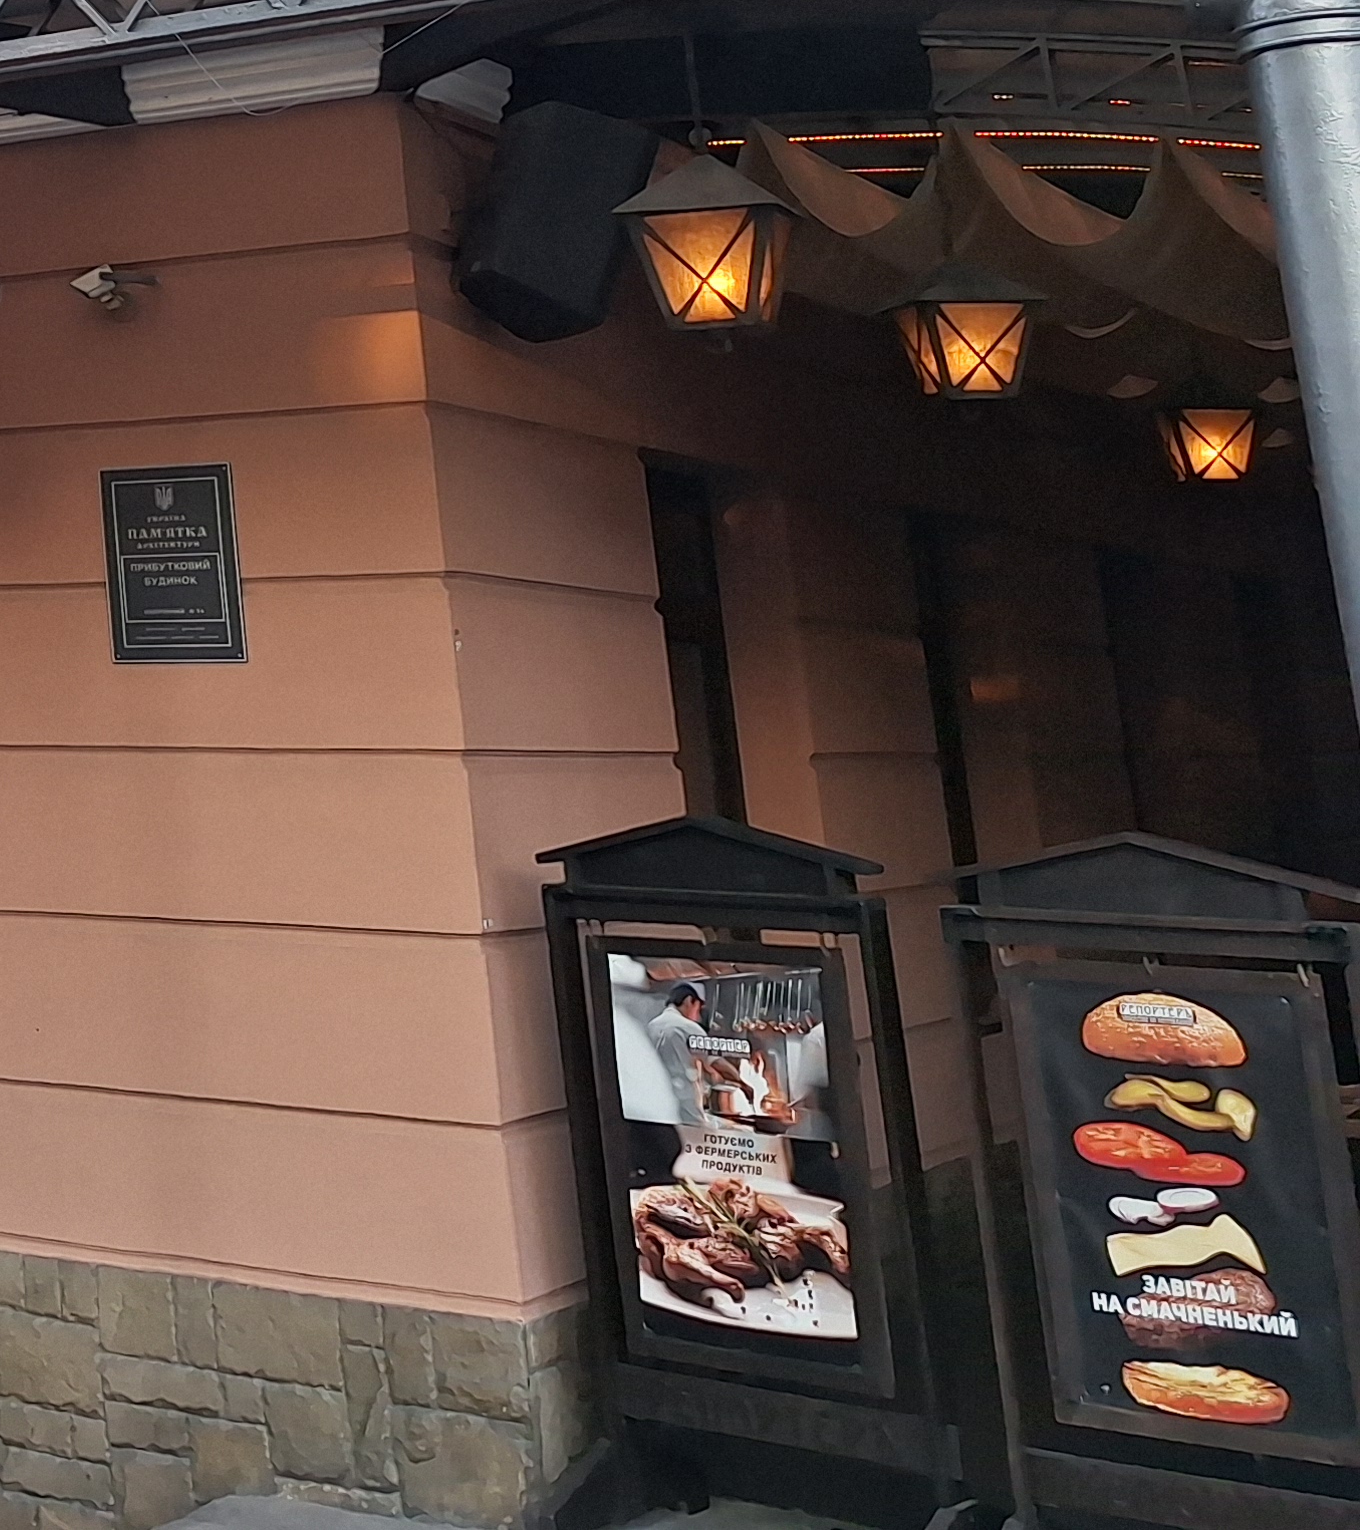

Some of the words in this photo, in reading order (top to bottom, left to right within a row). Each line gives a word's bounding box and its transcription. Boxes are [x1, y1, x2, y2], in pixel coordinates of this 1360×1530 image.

[129, 558, 212, 572] ПРИБУТКОВИЙ
[143, 575, 198, 587] БУДИНОК
[703, 1133, 755, 1149] ГОТУЄМО
[684, 1144, 692, 1154] З
[695, 1146, 778, 1165] ФЕРМЕРСЬКИХ
[701, 1159, 763, 1176] ПРОДУКТІВ
[1140, 1274, 1238, 1305] ЗАВІТАЙ
[1091, 1291, 1124, 1314] НА
[1125, 1296, 1298, 1338] СМАЧНЕНЬКИЙ
